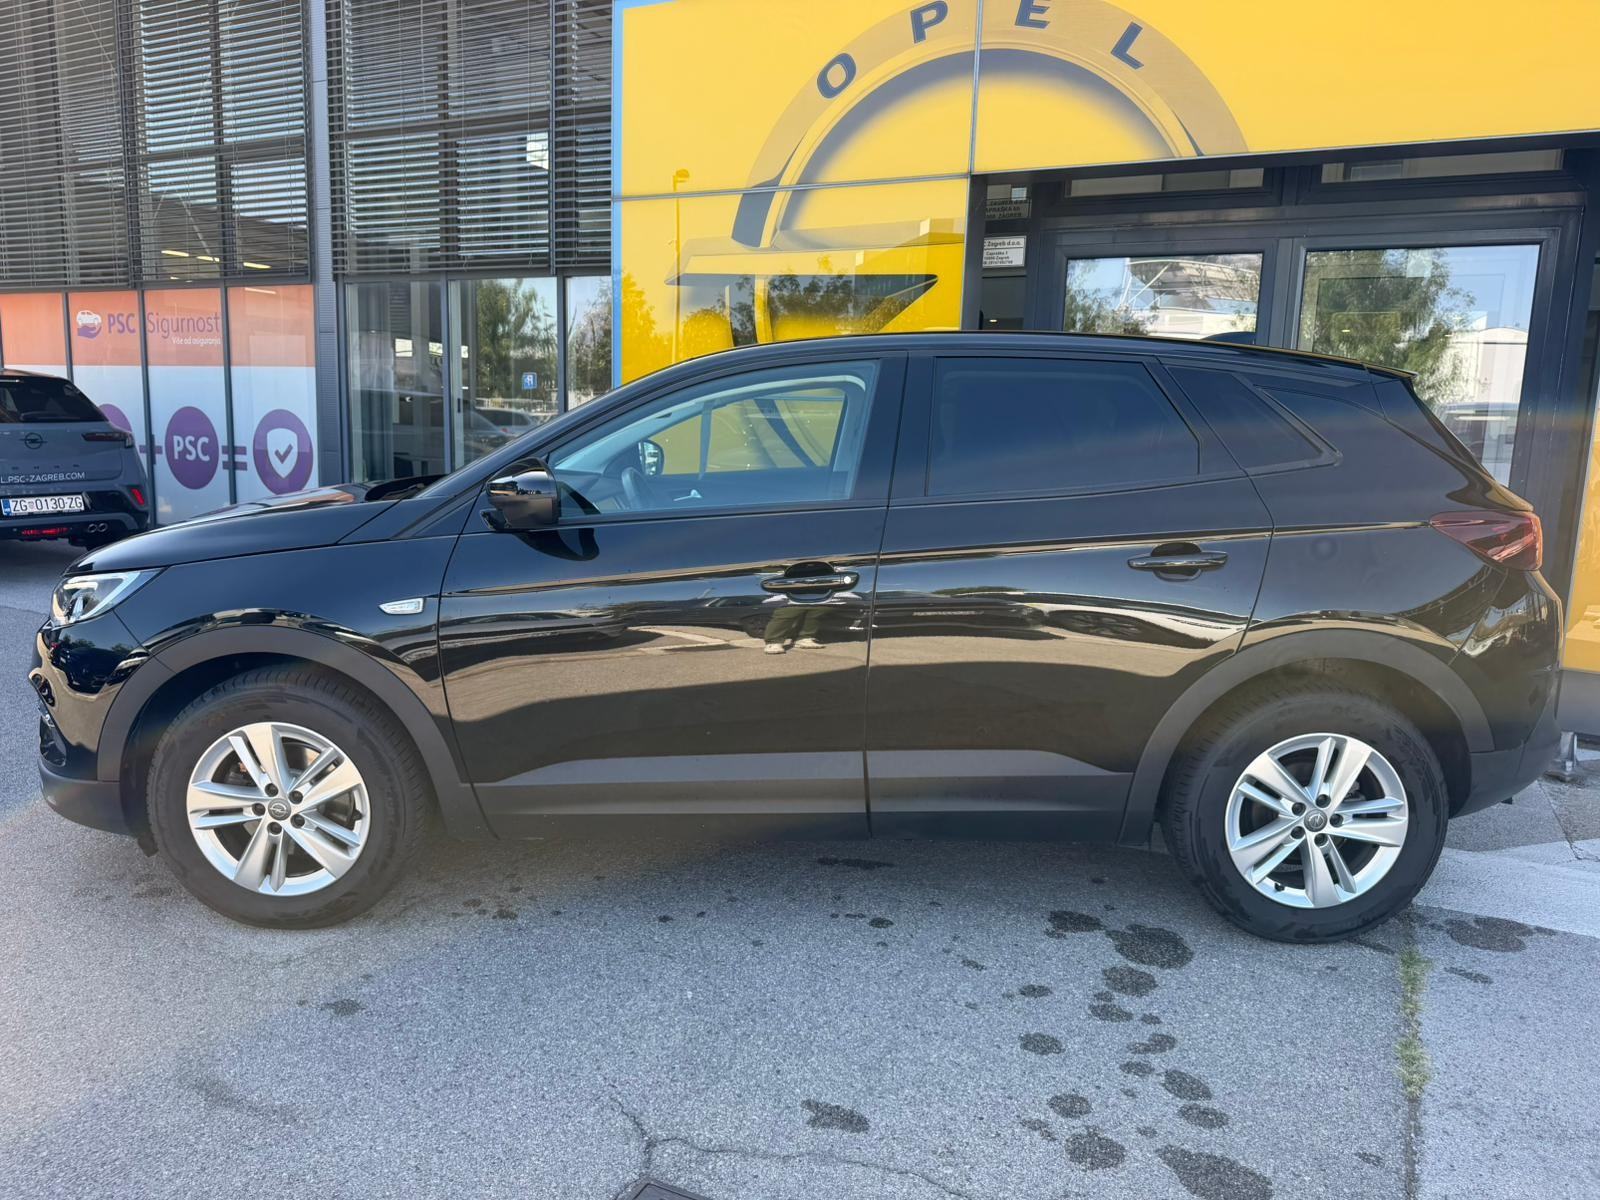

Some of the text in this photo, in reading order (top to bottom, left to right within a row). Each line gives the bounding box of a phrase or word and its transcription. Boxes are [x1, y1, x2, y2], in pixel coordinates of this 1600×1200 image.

[816, 0, 1145, 99] OPEL
[108, 311, 220, 339] PSC Sigurnost
[173, 435, 210, 461] PSC
